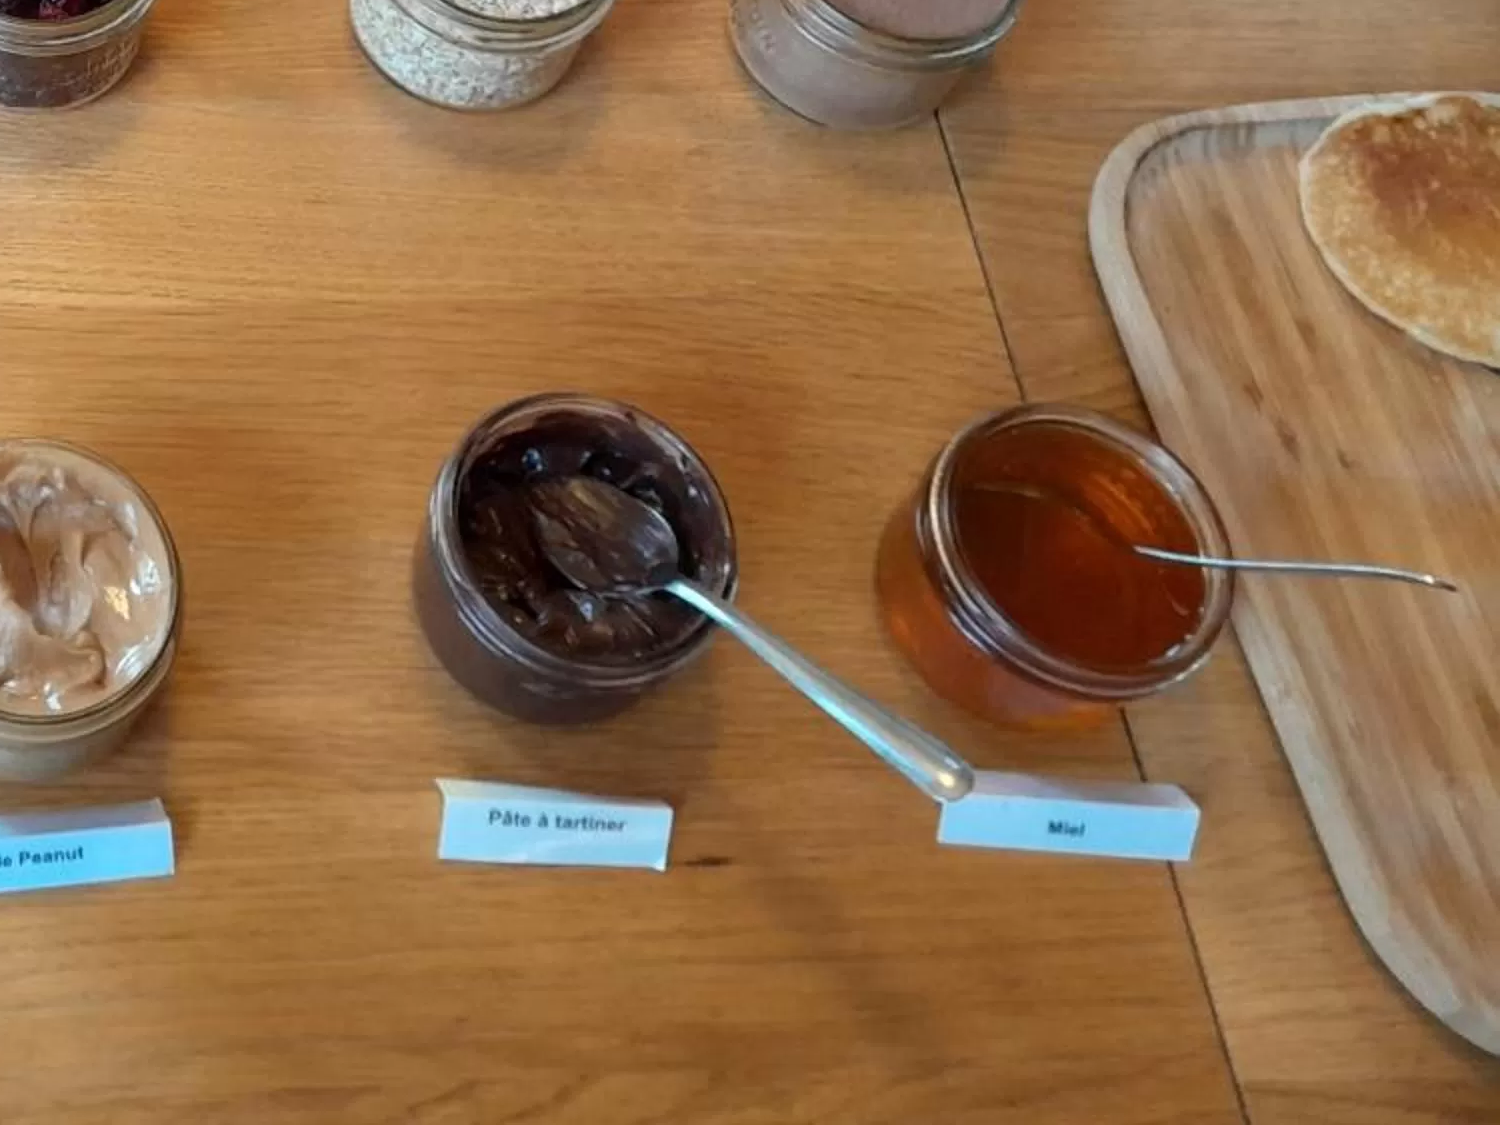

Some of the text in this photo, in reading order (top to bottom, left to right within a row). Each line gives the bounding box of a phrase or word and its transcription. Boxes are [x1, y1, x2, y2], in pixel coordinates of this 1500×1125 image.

[488, 810, 626, 832] Pâte à tartiner
[1047, 820, 1086, 837] Miel
[19, 846, 84, 867] Peanut
